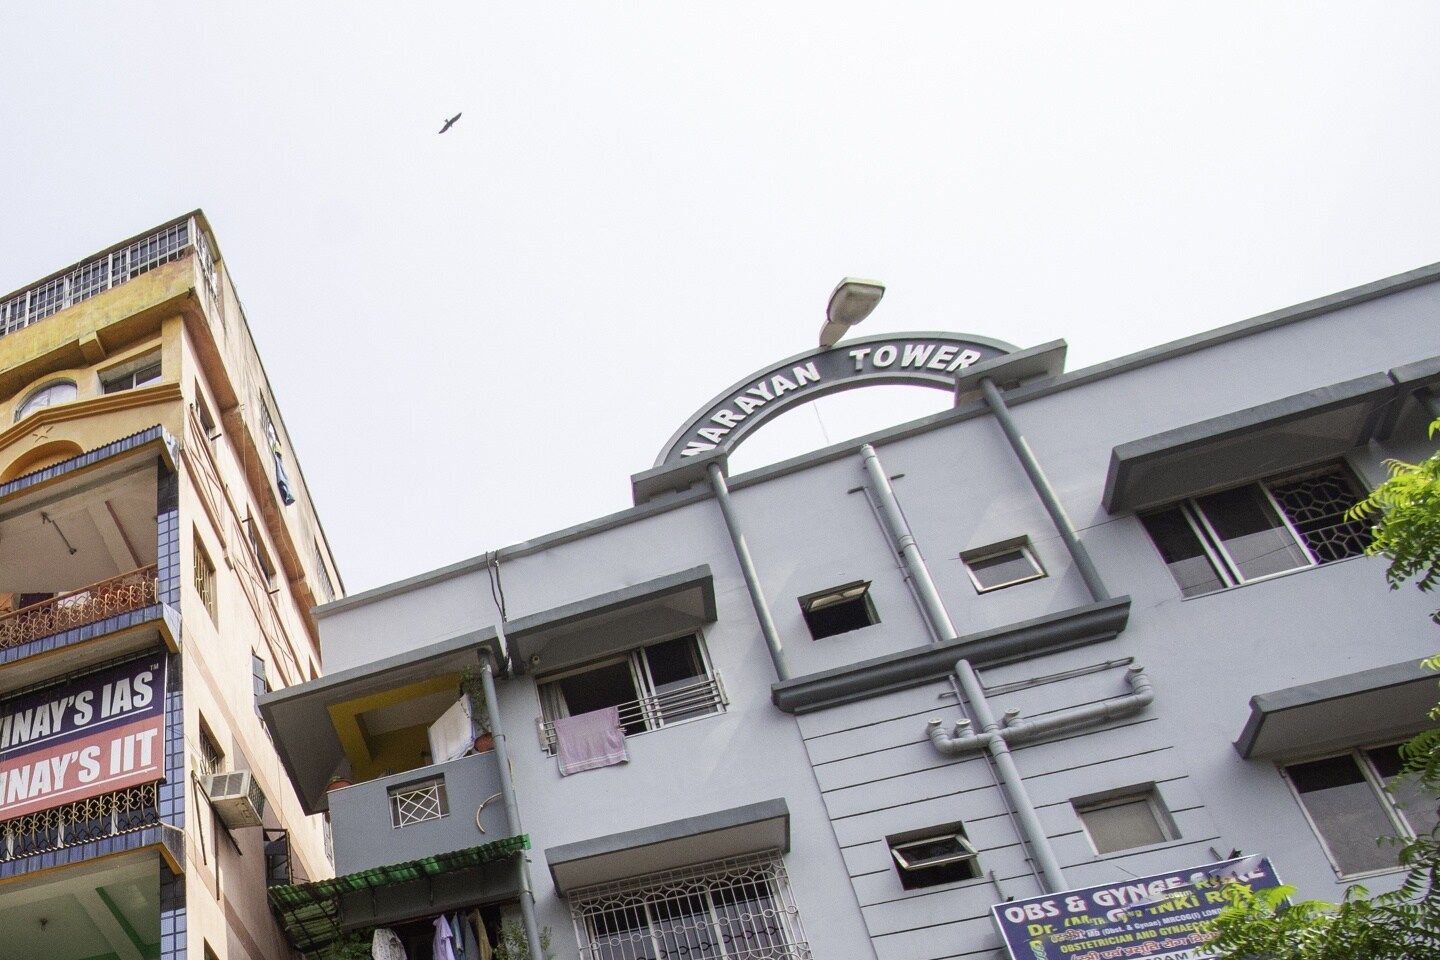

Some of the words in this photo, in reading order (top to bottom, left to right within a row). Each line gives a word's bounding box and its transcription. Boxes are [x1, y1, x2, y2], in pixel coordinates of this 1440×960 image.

[681, 362, 820, 457] NARAYAN
[849, 344, 981, 373] TOWER
[101, 671, 153, 718] IAS
[110, 728, 157, 775] IIT
